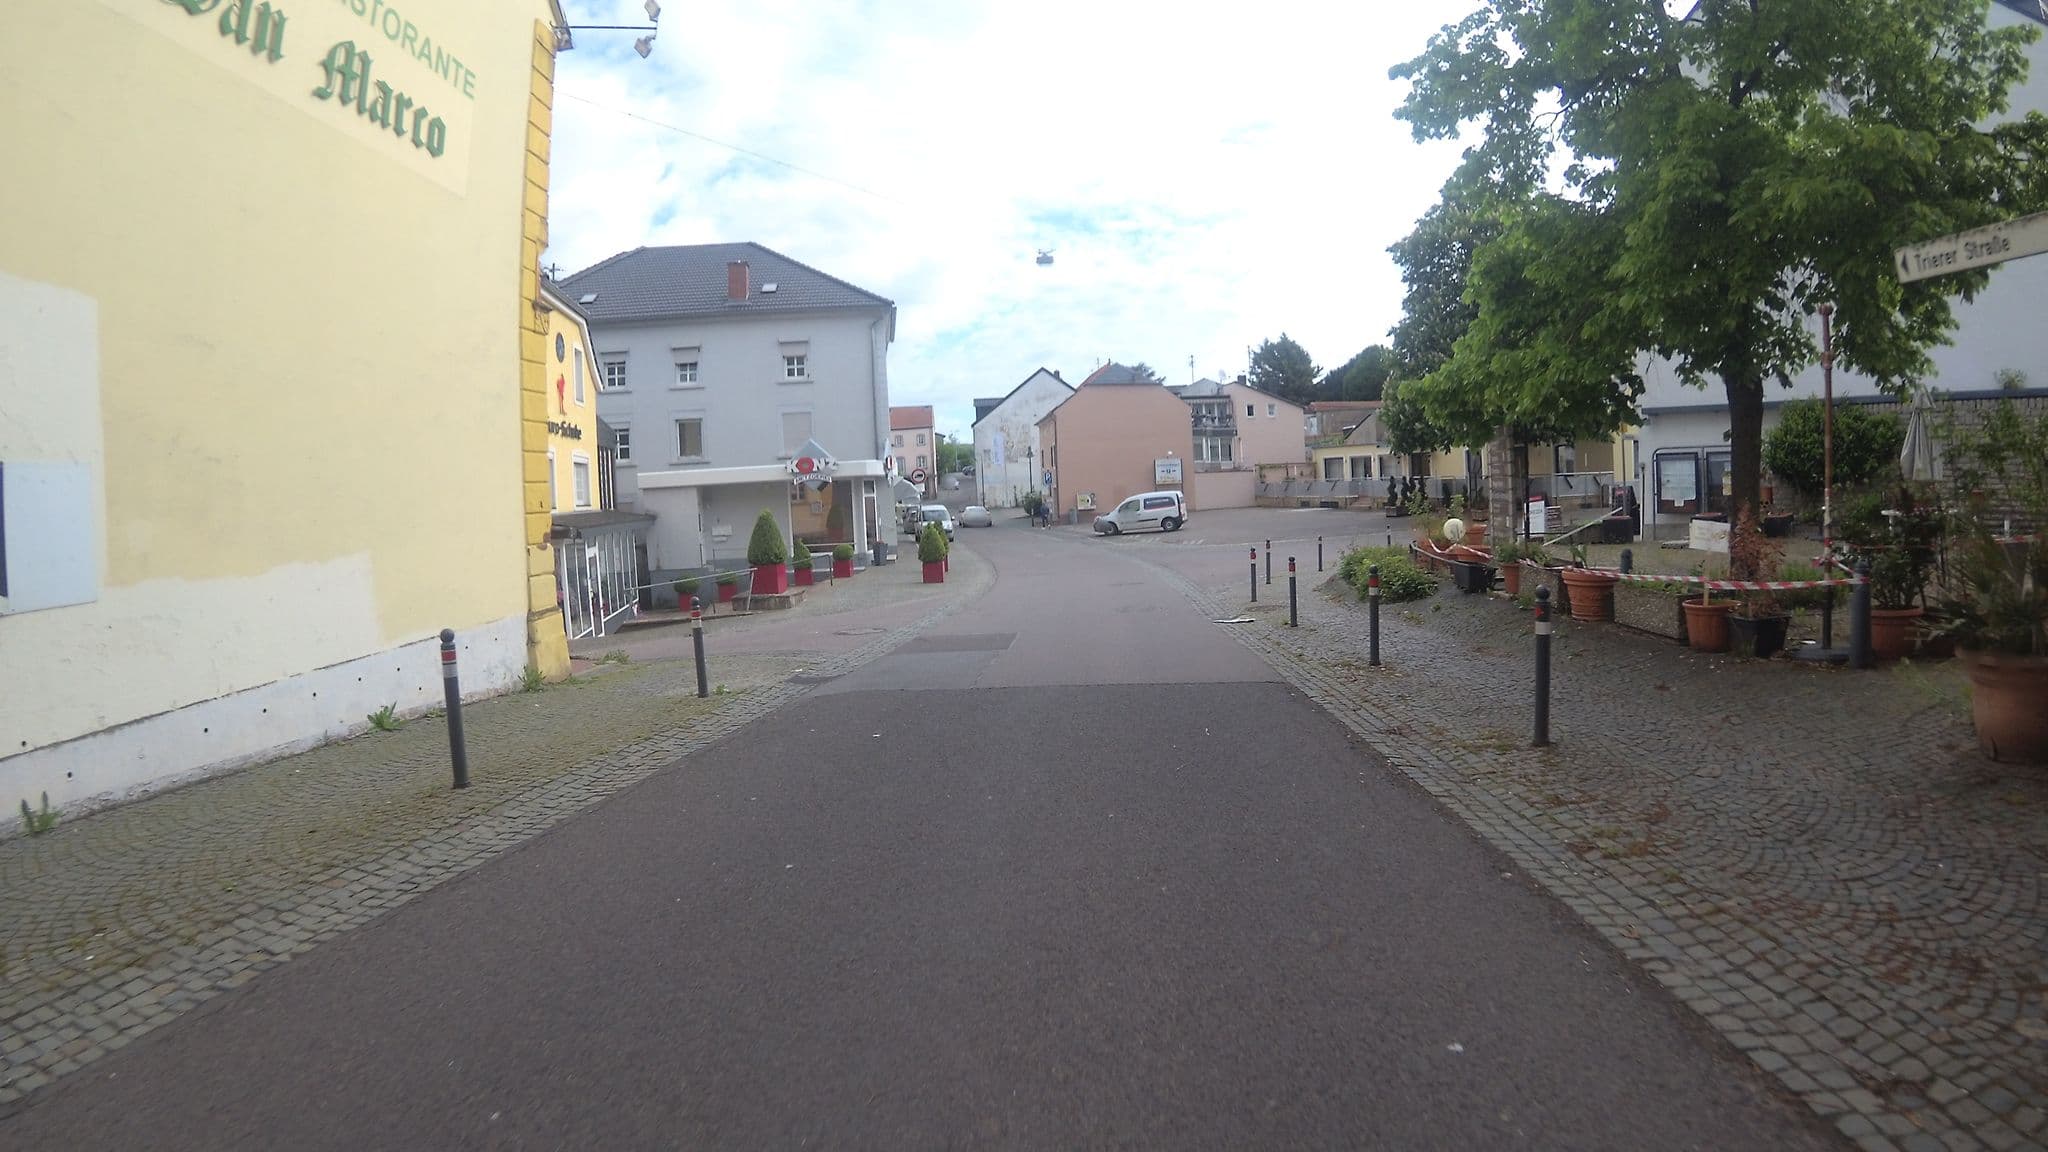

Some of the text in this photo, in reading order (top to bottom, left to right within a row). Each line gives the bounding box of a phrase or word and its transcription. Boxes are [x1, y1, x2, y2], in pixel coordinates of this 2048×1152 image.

[158, 0, 447, 159] an Marco
[1914, 235, 2010, 272] Trierer Straße
[786, 456, 838, 474] KONZ
